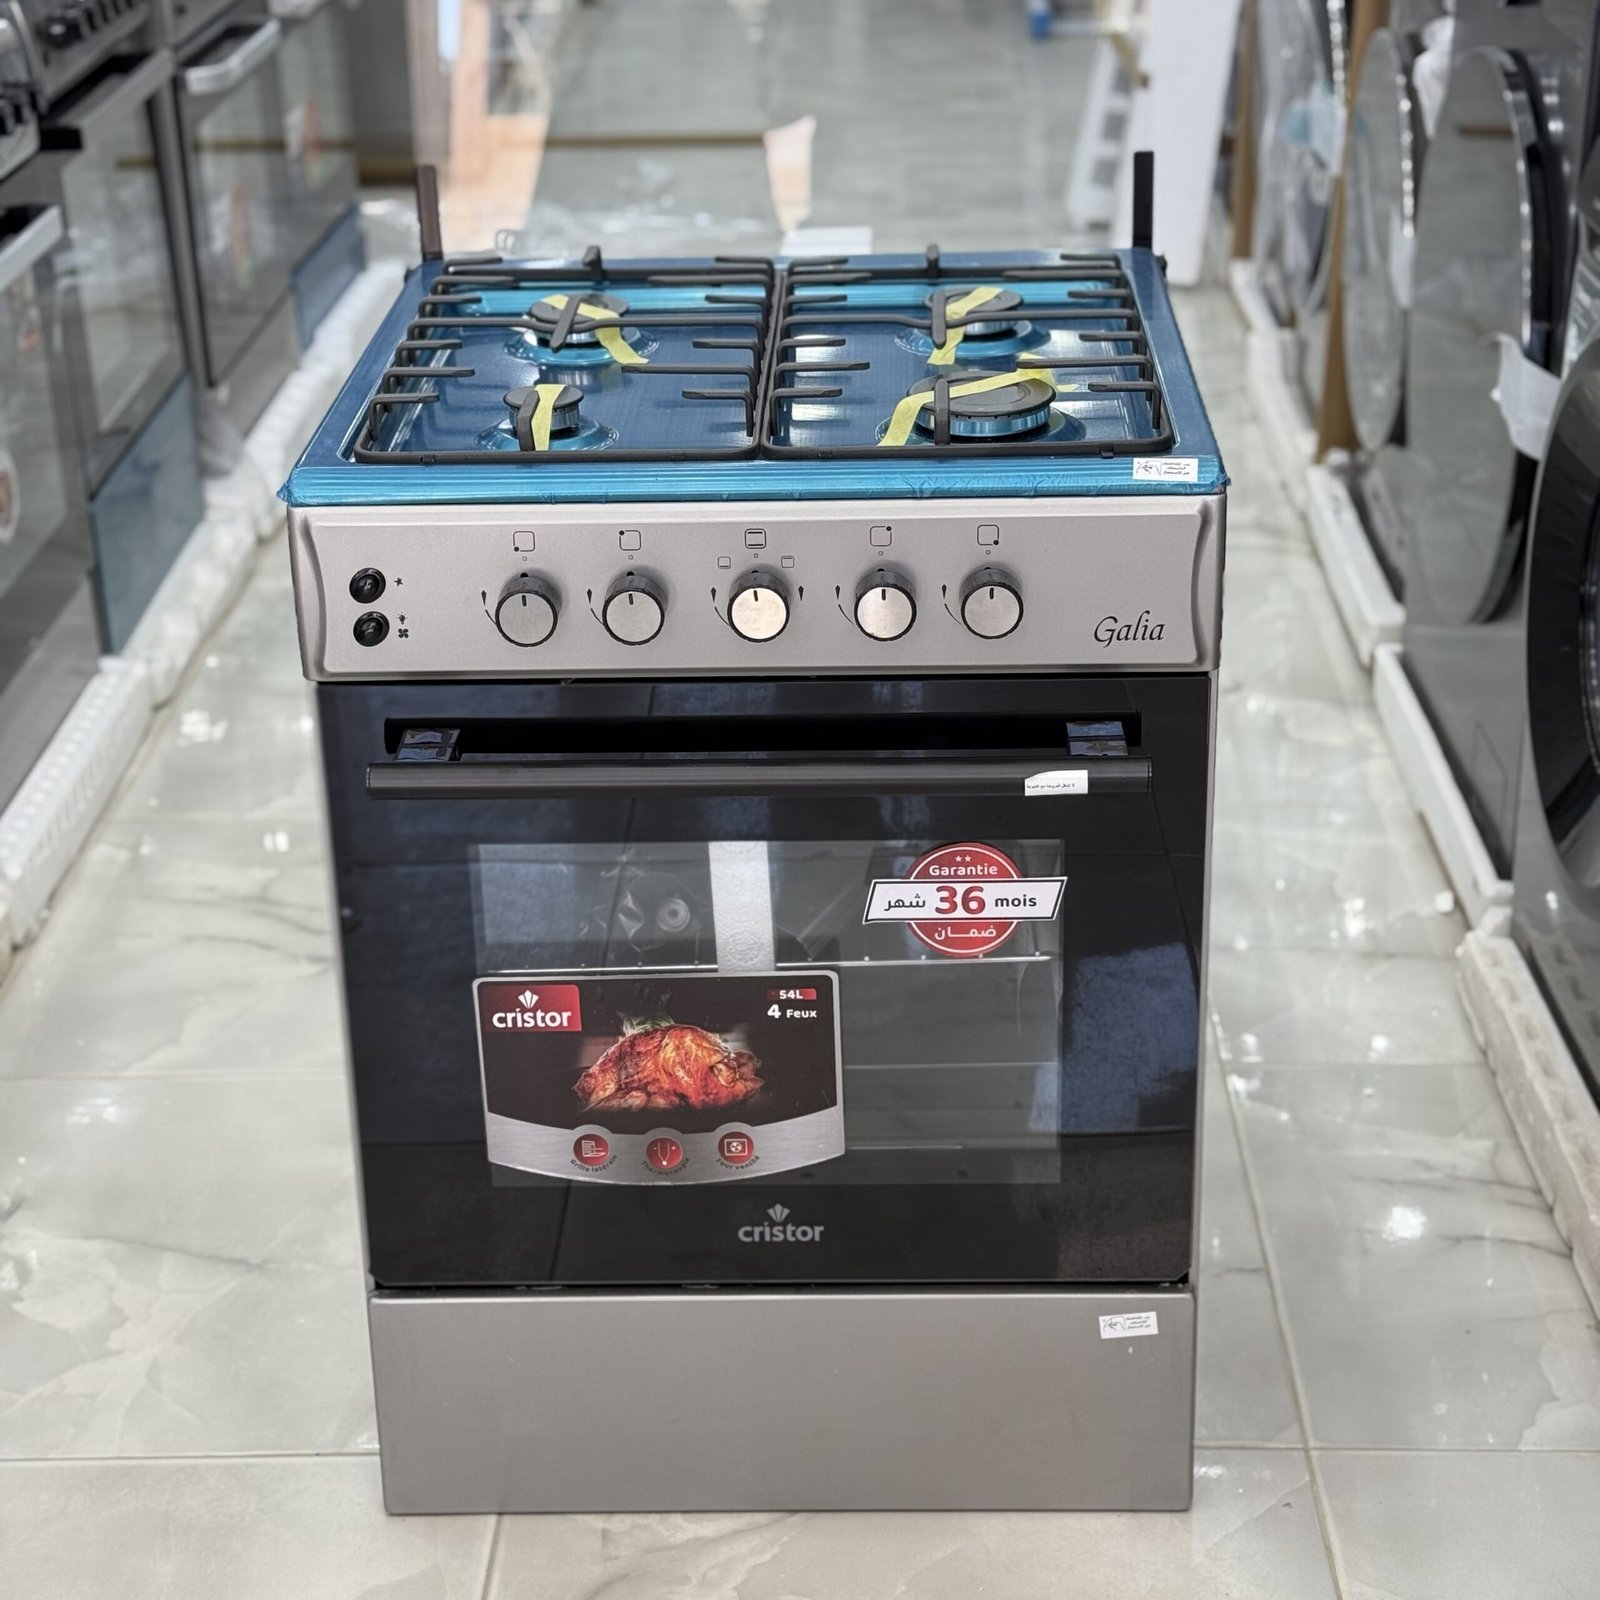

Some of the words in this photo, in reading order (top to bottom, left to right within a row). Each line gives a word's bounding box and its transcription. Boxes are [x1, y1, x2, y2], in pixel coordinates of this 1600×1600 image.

[1093, 609, 1166, 649] Galia
[928, 863, 999, 877] Garantie
[884, 893, 926, 912] شهر
[934, 885, 987, 915] 36
[994, 894, 1038, 908] mois
[779, 989, 804, 1000] 54L
[492, 1007, 572, 1028] cristor
[767, 1003, 782, 1019] 4
[786, 1009, 818, 1019] Feux
[737, 1221, 825, 1242] cristor
